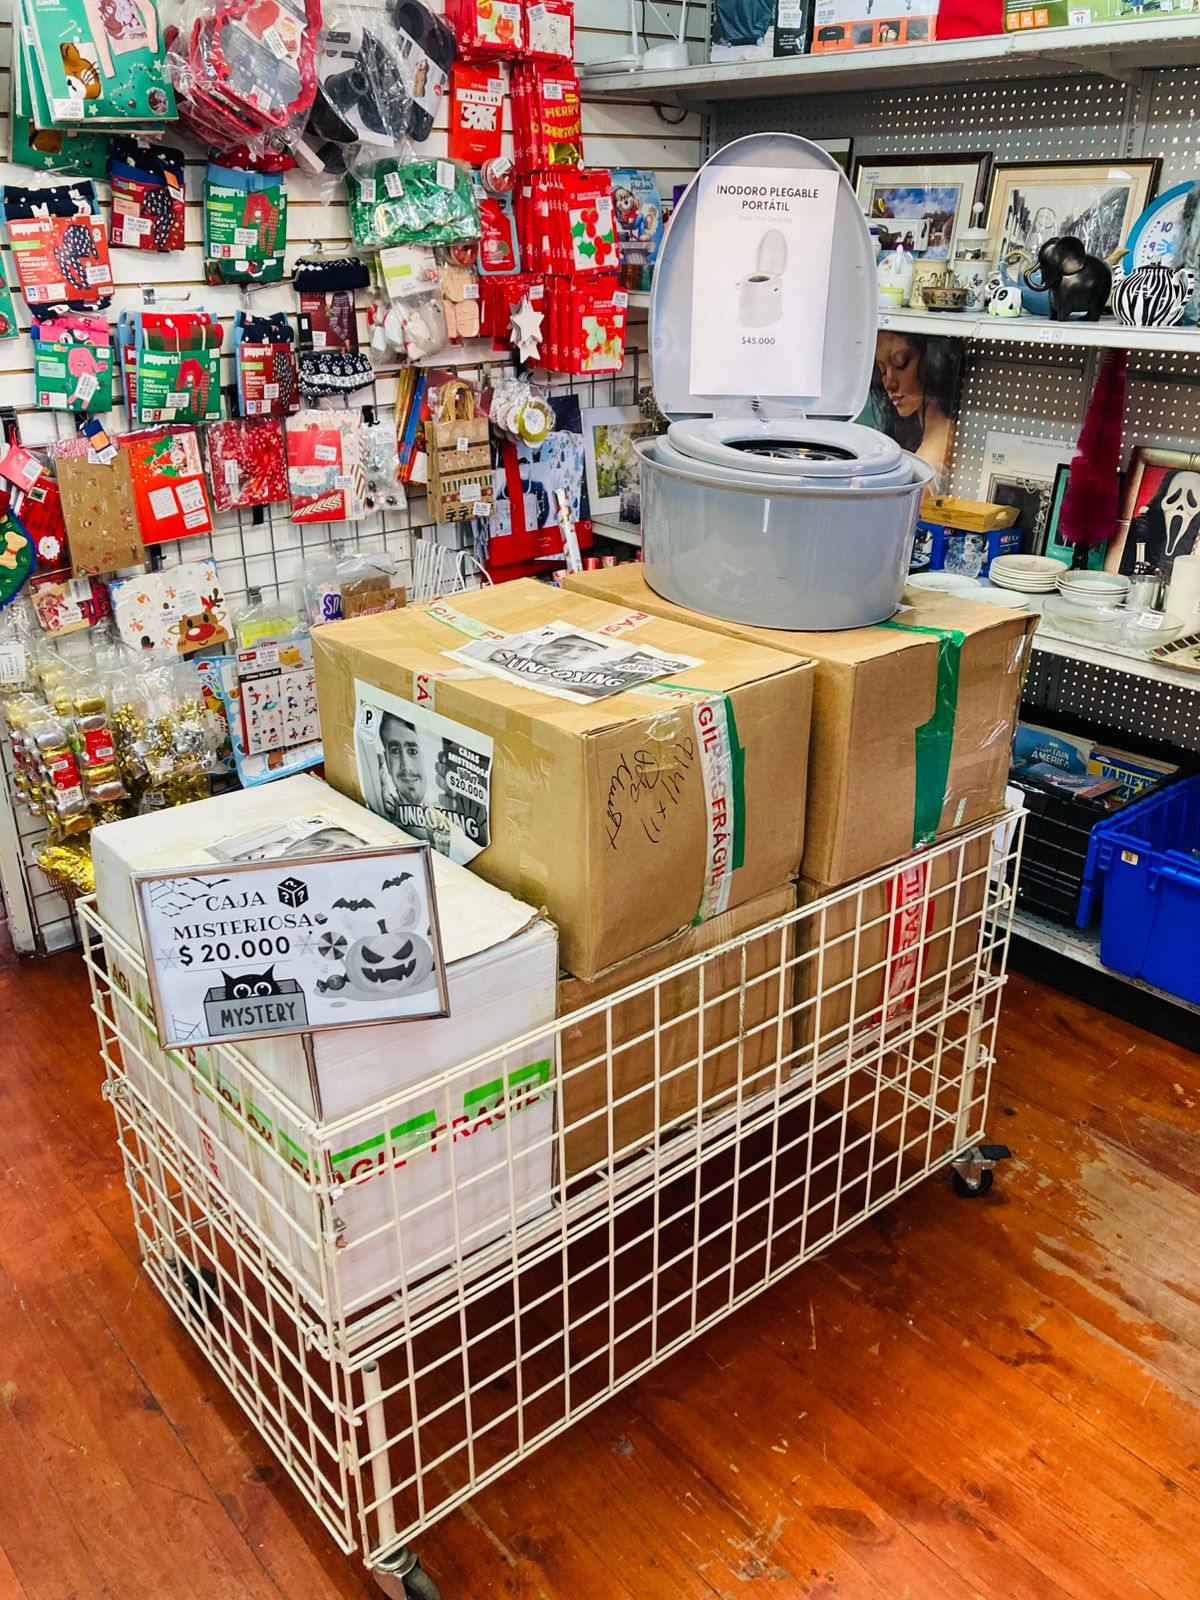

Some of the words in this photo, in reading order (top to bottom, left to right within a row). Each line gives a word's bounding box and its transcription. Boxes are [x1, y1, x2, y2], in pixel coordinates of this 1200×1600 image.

[545, 104, 579, 118] MERRY
[716, 185, 768, 197] INODORO
[769, 187, 820, 199] PLEGABLE
[741, 199, 790, 212] PORTÁTIL
[1161, 221, 1173, 232] 10
[1149, 242, 1156, 252] 9
[741, 336, 776, 345] $45.000
[506, 658, 627, 688] UNBOXING
[365, 710, 373, 725] P
[458, 746, 480, 764] CAJAS
[1031, 750, 1070, 769] AMERICA
[450, 775, 484, 800] $20.000
[398, 804, 480, 839] UNBOXING
[711, 796, 731, 886] FRÁGIL
[205, 891, 267, 911] CAJA
[173, 912, 313, 941] MISTERIOSA
[220, 1001, 296, 1029] MYSTERY
